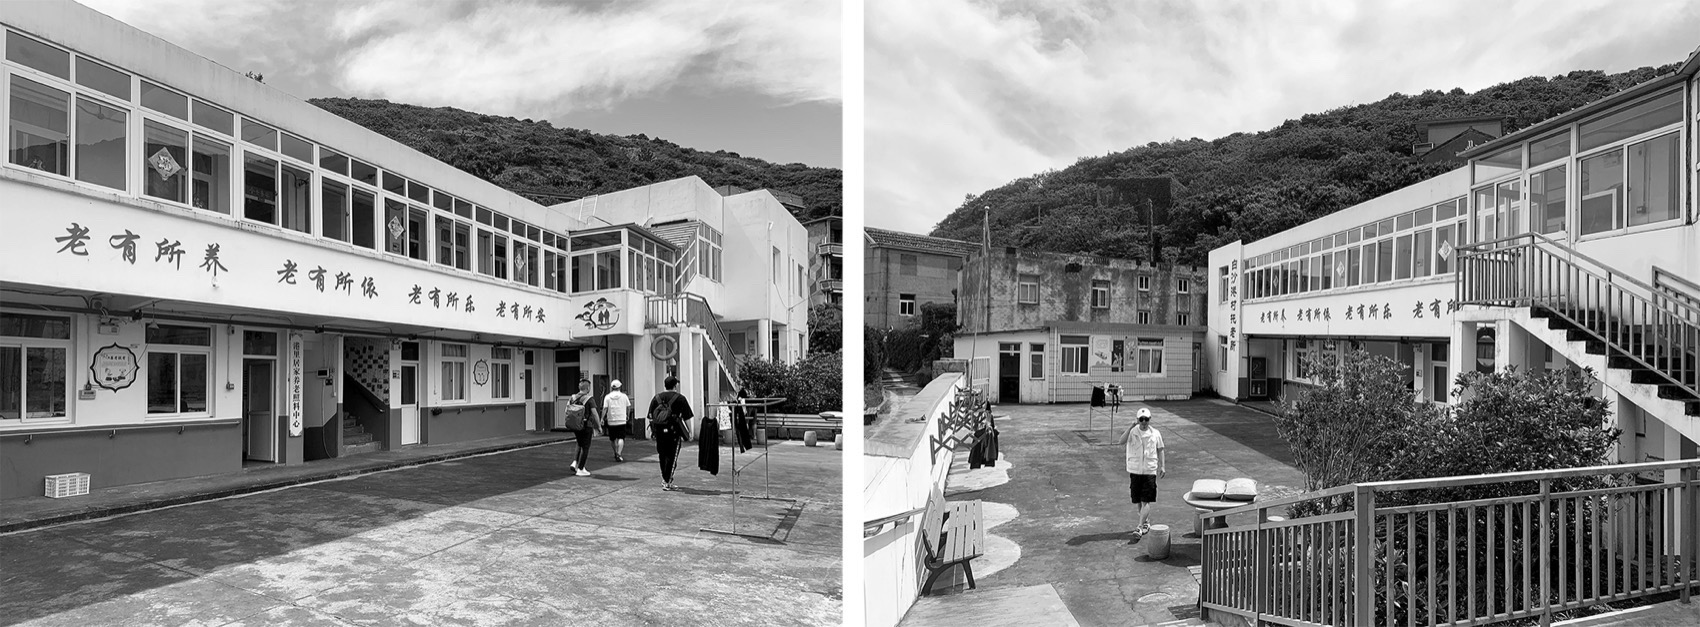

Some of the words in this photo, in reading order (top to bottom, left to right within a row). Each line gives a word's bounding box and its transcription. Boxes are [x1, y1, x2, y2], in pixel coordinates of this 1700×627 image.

[55, 222, 228, 276] 老有所养
[277, 259, 378, 298] 老有所依
[408, 284, 475, 313] 老有所乐
[495, 300, 546, 323] 老有所安
[1345, 302, 1392, 320] 老有所乐
